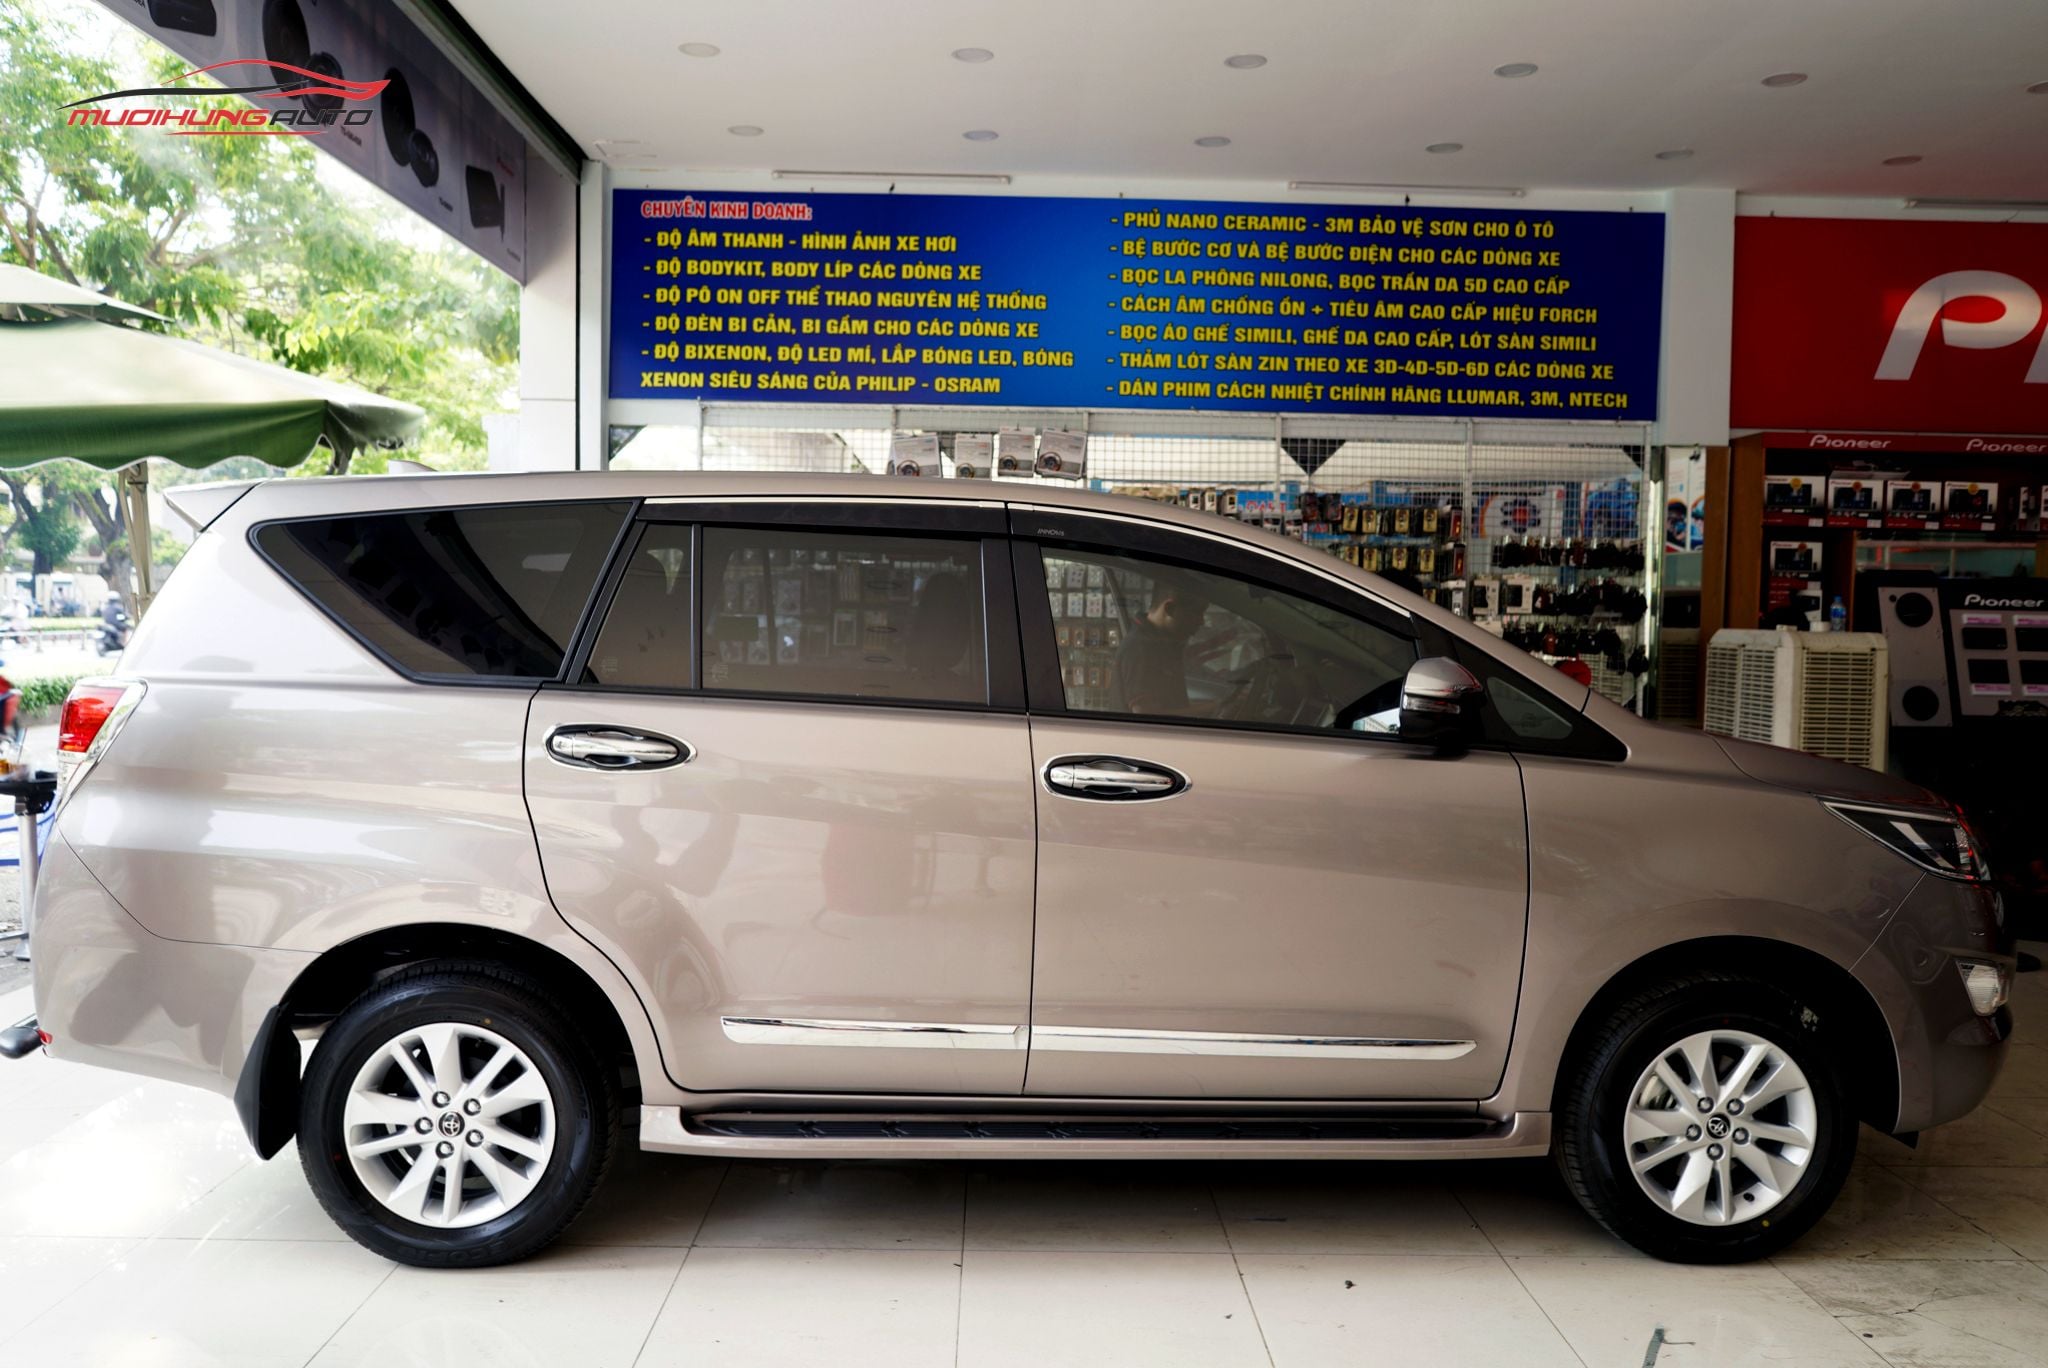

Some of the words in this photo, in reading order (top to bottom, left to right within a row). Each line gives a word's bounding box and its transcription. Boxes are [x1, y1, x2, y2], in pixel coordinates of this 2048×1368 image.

[641, 196, 706, 218] CHUYÊN
[709, 201, 748, 219] KINH
[752, 201, 812, 220] DOANH:
[1123, 208, 1160, 228] PHỦ
[1166, 213, 1218, 229] NANO
[1223, 214, 1306, 232] CERAMIC
[1324, 217, 1354, 233] 3M
[1358, 213, 1396, 235] BẢO
[1401, 216, 1423, 238] VỆ
[1429, 219, 1468, 237] SƠN
[1472, 221, 1510, 238] CHO
[1514, 219, 1527, 238] Ô
[1531, 220, 1554, 239] TÔ
[656, 227, 682, 249] ĐỘ
[687, 228, 717, 247] ÂM
[722, 231, 783, 248] THANH
[801, 231, 847, 250] HÌNH
[851, 230, 891, 251] ẢNH
[896, 235, 920, 251] XE
[925, 235, 956, 252] HƠI
[1122, 237, 1146, 258] BỆ
[1151, 239, 1200, 257] BƯỚC
[1206, 241, 1232, 258] CƠ
[1236, 240, 1260, 258] VÀ
[1265, 241, 1289, 262] BỆ
[1294, 242, 1344, 261] BƯỚC
[1348, 243, 1393, 265] ĐIỆN
[1397, 246, 1435, 264] CHO
[1440, 246, 1477, 265] CÁC
[1482, 247, 1532, 266] DÒNG
[1537, 250, 1561, 267] XE
[655, 256, 681, 278] ĐỘ
[686, 259, 766, 277] BODYKIT,
[771, 261, 819, 277] BODY
[824, 260, 853, 278] LÍP
[858, 260, 896, 279] CÁC
[901, 261, 952, 280] DÒNG
[958, 265, 981, 280] XE
[1121, 268, 1159, 286] BỌC
[1164, 269, 1186, 284] LA
[1191, 268, 1255, 286] PHÔNG
[1259, 271, 1333, 290] NILONG,
[1338, 273, 1376, 292] BỌC
[1434, 276, 1459, 292] DA
[1463, 276, 1488, 293] 5D
[1492, 277, 1529, 294] CAO
[1533, 274, 1570, 295] CẤP
[655, 284, 681, 306] ĐỘ
[685, 284, 711, 303] PÔ
[716, 287, 743, 304] ON
[747, 288, 781, 305] OFF
[824, 290, 872, 307] THAO
[876, 289, 952, 308] NGUYÊN
[956, 290, 980, 311] HỆ
[986, 290, 1047, 309] THỐNG
[1121, 293, 1170, 312] CÁCH
[1175, 294, 1205, 313] ÂM
[1211, 295, 1274, 315] CHỐNG
[1311, 304, 1323, 315] +
[1329, 298, 1369, 318] TIÊU
[1373, 299, 1404, 319] ÂM
[1408, 303, 1445, 320] CAO
[1450, 300, 1488, 321] CẤP
[1492, 303, 1534, 325] HIỆU
[1538, 306, 1597, 324] FORCH
[654, 312, 680, 334] ĐỘ
[684, 313, 723, 332] ĐÈN
[727, 316, 747, 332] BI
[752, 312, 796, 335] CẢN,
[801, 317, 821, 334] BI
[873, 319, 911, 336] CHO
[916, 317, 953, 336] CÁC
[959, 318, 1010, 337] DÒNG
[1015, 322, 1039, 338] XE
[1120, 324, 1157, 342] BỌC
[1162, 322, 1187, 341] ÁO
[1192, 323, 1229, 342] GHẾ
[1234, 326, 1297, 345] SIMILI,
[1302, 325, 1339, 345] GHẾ
[1343, 329, 1369, 346] DA
[1373, 330, 1410, 347] CAO
[1415, 327, 1454, 350] CẤP,
[1459, 330, 1492, 349] LÓT
[1496, 331, 1535, 350] SÀN
[1539, 334, 1597, 352] SIMILI
[653, 340, 680, 362] ĐỘ
[684, 343, 772, 363] BIXENON,
[776, 342, 803, 365] ĐỘ
[807, 345, 842, 363] LED
[846, 344, 876, 365] MÍ,
[921, 346, 973, 364] BÓNG
[978, 349, 1017, 367] LED,
[1022, 348, 1073, 366] BÓNG
[1119, 348, 1171, 368] THẢM
[1176, 351, 1209, 369] LÓT
[1214, 352, 1253, 370] SÀN
[1257, 355, 1289, 371] ZIN
[1294, 356, 1340, 373] THEO
[1345, 357, 1369, 374] XE
[1373, 358, 1489, 377] 3D-4D-5D-6D
[1494, 359, 1531, 378] CÁC
[1535, 360, 1586, 379] DÒNG
[1590, 364, 1615, 380] XE
[640, 371, 704, 387] XENON
[709, 369, 752, 389] SIÊU
[757, 371, 808, 390] SÁNG
[813, 370, 851, 391] CỦA
[855, 375, 916, 392] PHILIP
[933, 376, 1000, 393] OSRAM
[1119, 378, 1157, 396] DÁN
[1162, 381, 1210, 397] PHIM
[1216, 380, 1266, 398] CÁCH
[1270, 381, 1324, 403] NHIỆT
[1328, 383, 1386, 401] CHÍNH
[1390, 384, 1441, 404] HÃNG
[1446, 388, 1525, 407] LLUMAR,
[1530, 390, 1563, 408] 3M,
[1568, 391, 1628, 408] NTECH
[1810, 434, 1892, 450] Pioneer
[1966, 438, 2048, 454] Pioneer
[1964, 593, 2045, 609] Pioneer
